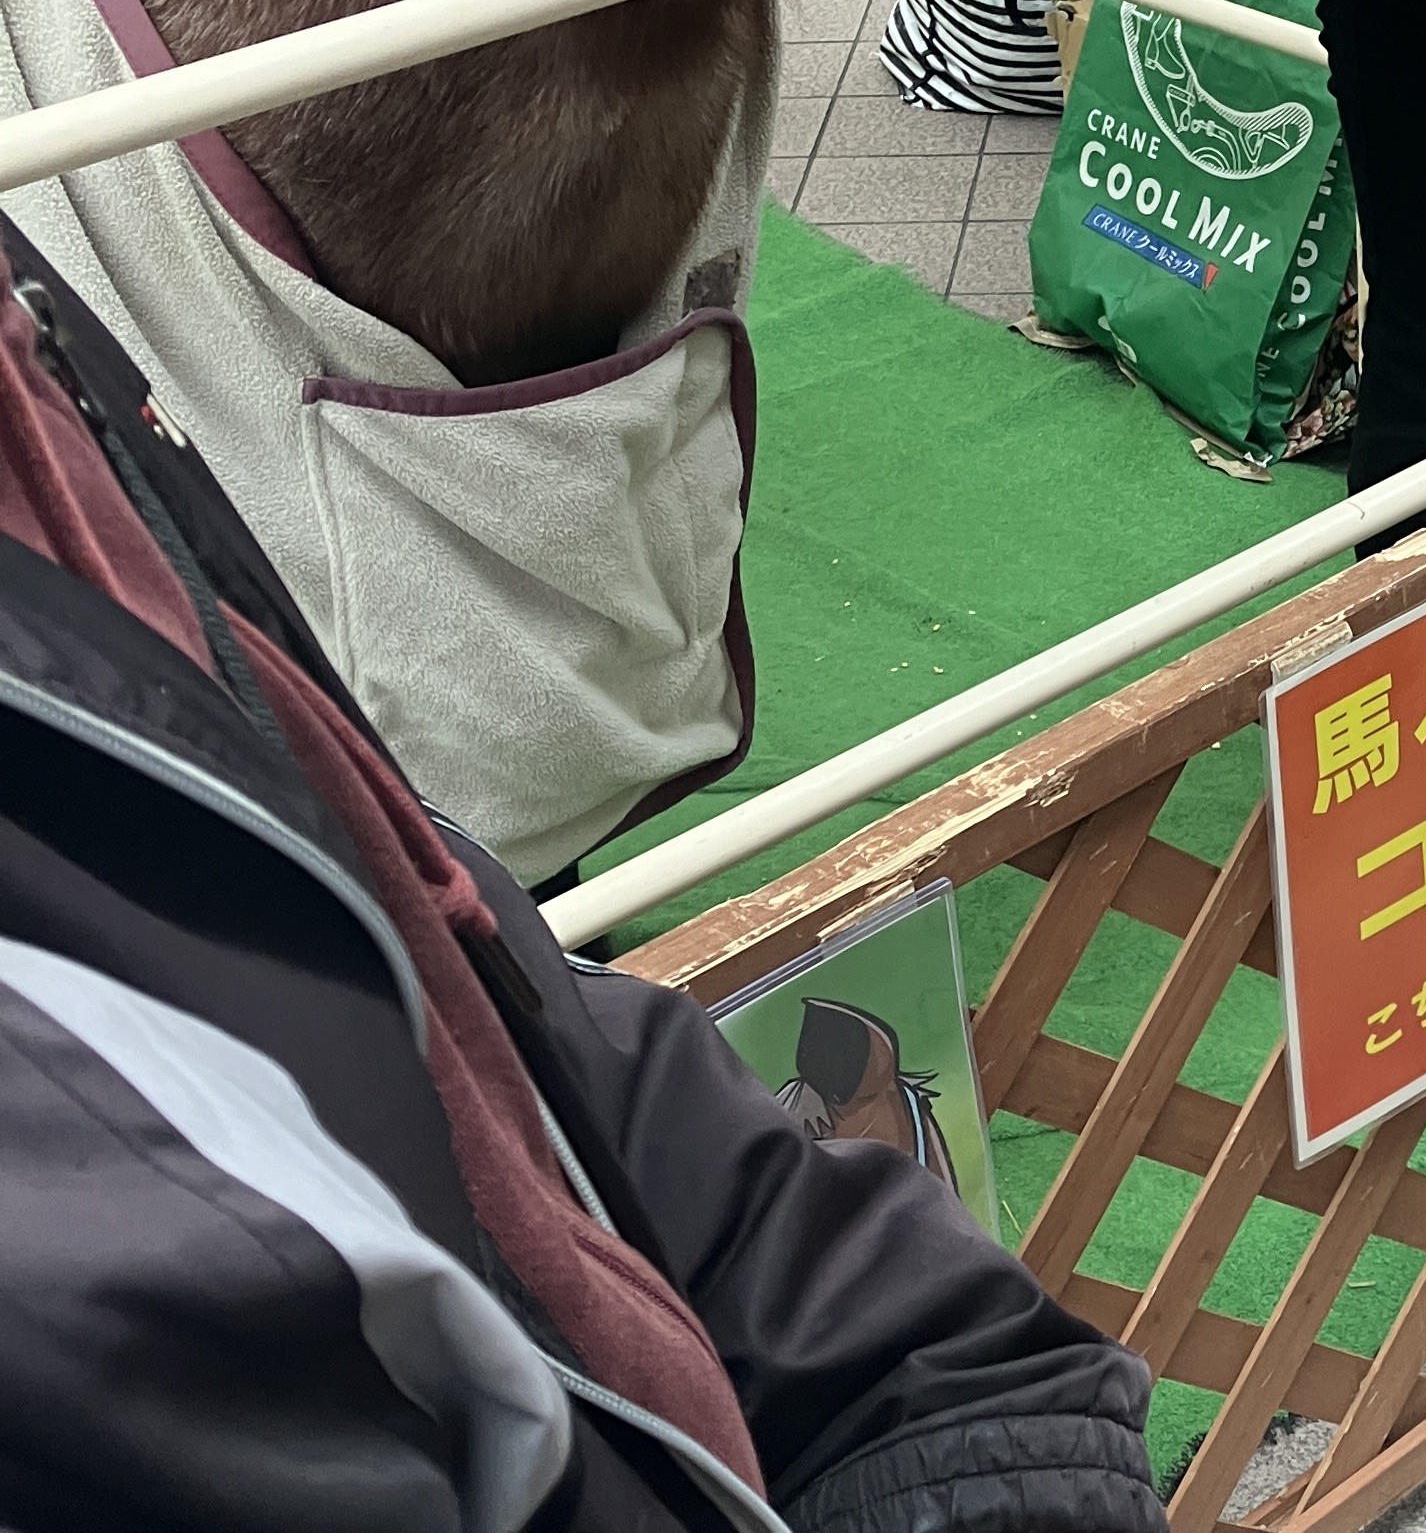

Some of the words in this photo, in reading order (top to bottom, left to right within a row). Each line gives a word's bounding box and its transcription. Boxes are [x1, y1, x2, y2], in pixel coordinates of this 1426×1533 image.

[1087, 108, 1161, 160] CRANE
[1079, 140, 1181, 230] COOL
[1187, 195, 1272, 273] MIX
